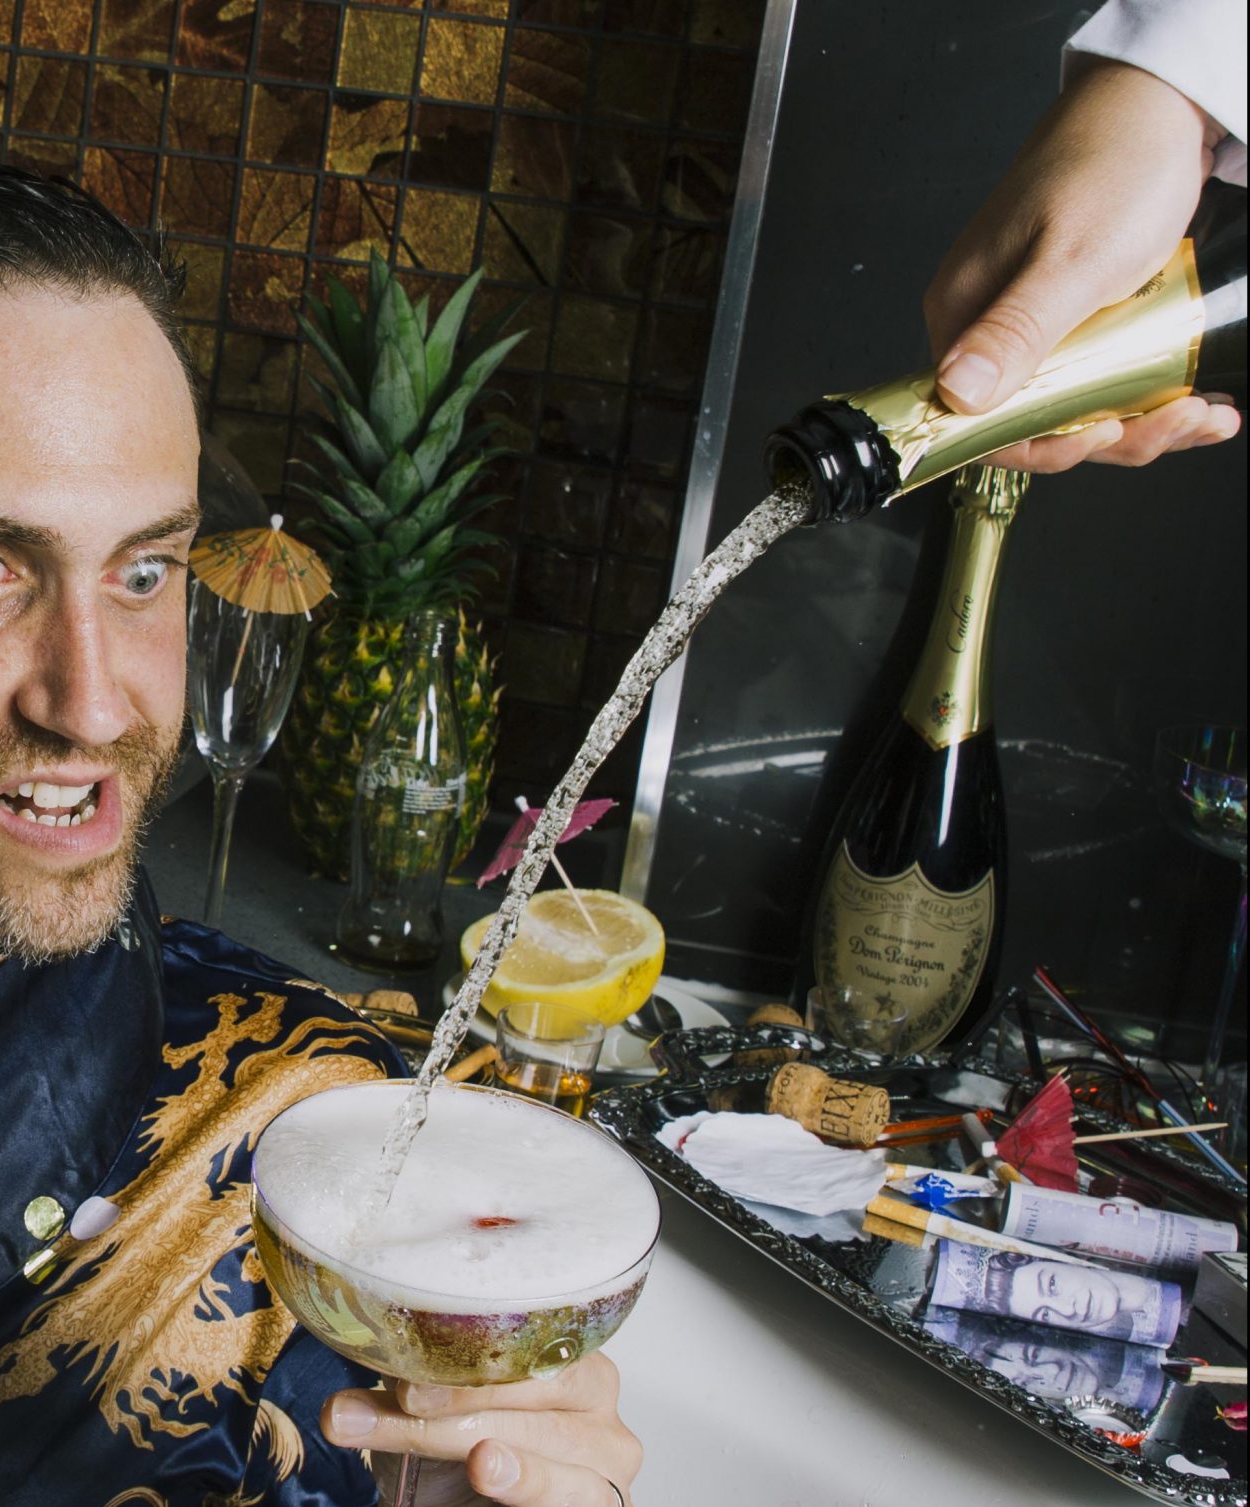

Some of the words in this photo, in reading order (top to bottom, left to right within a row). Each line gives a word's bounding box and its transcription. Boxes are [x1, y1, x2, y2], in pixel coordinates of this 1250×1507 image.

[849, 935, 882, 962] Dom
[883, 947, 946, 974] Pérignon
[864, 924, 935, 951] Champagne
[855, 964, 898, 986] Vintage
[1022, 1198, 1040, 1238] unds
[1181, 1230, 1199, 1266] land
